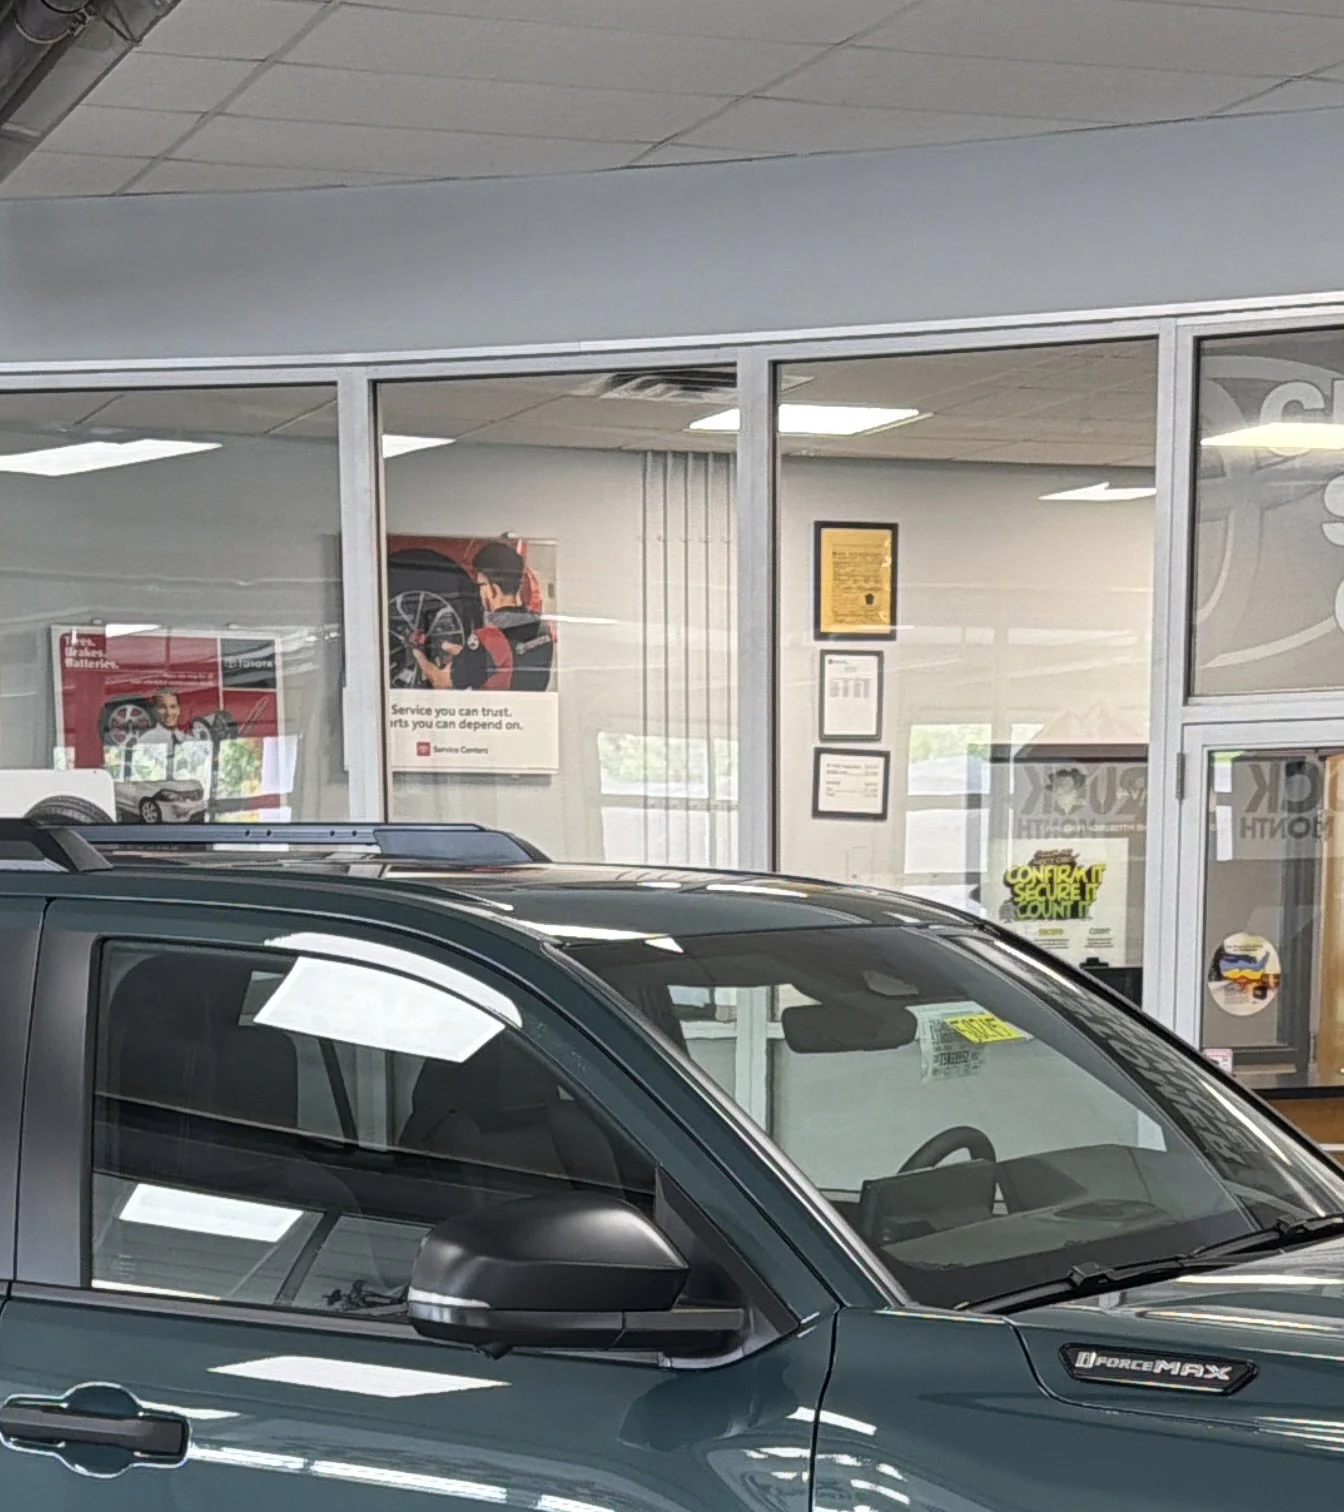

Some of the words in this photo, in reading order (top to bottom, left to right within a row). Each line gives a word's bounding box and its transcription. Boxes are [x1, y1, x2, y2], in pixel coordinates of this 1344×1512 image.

[65, 636, 96, 647] Tres.
[391, 704, 432, 716] Service
[434, 707, 456, 719] you
[458, 708, 479, 717] can
[481, 706, 513, 717] trust.
[412, 720, 433, 731] you
[435, 720, 456, 729] can
[458, 719, 503, 731] depend
[505, 721, 524, 730] on.
[433, 745, 459, 753] Service
[1006, 864, 1088, 885] CONFIRM
[1091, 863, 1108, 884] IT
[1013, 883, 1080, 901] SECURE
[1085, 883, 1099, 900] IT
[1017, 900, 1075, 919] COUNT
